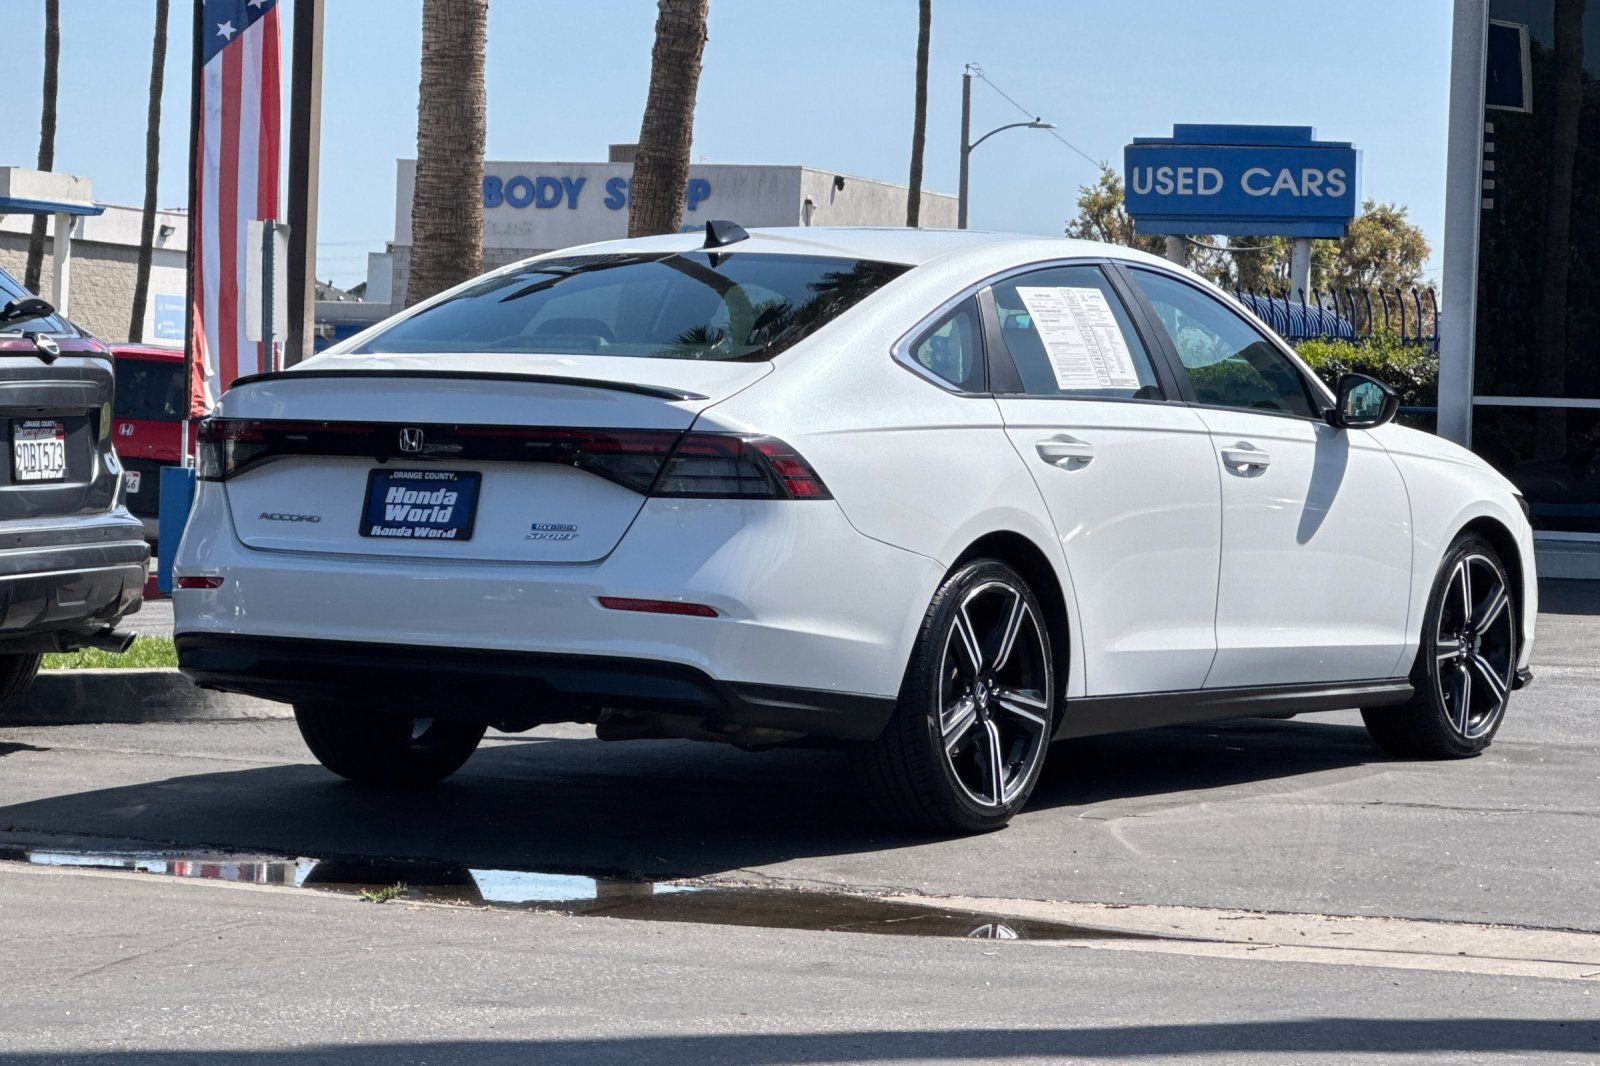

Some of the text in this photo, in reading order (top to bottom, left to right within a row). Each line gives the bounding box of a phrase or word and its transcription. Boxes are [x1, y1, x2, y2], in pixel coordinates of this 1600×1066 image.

[1132, 166, 1347, 198] USED CARS
[483, 175, 712, 212] BODY SP
[15, 442, 64, 470] 9DBT573
[393, 472, 455, 480] ORANGE COUNTY
[385, 486, 458, 506] Honda
[257, 512, 320, 523] ACCORD
[384, 504, 453, 523] World
[371, 525, 412, 537] Honda
[524, 533, 579, 541] SPORT
